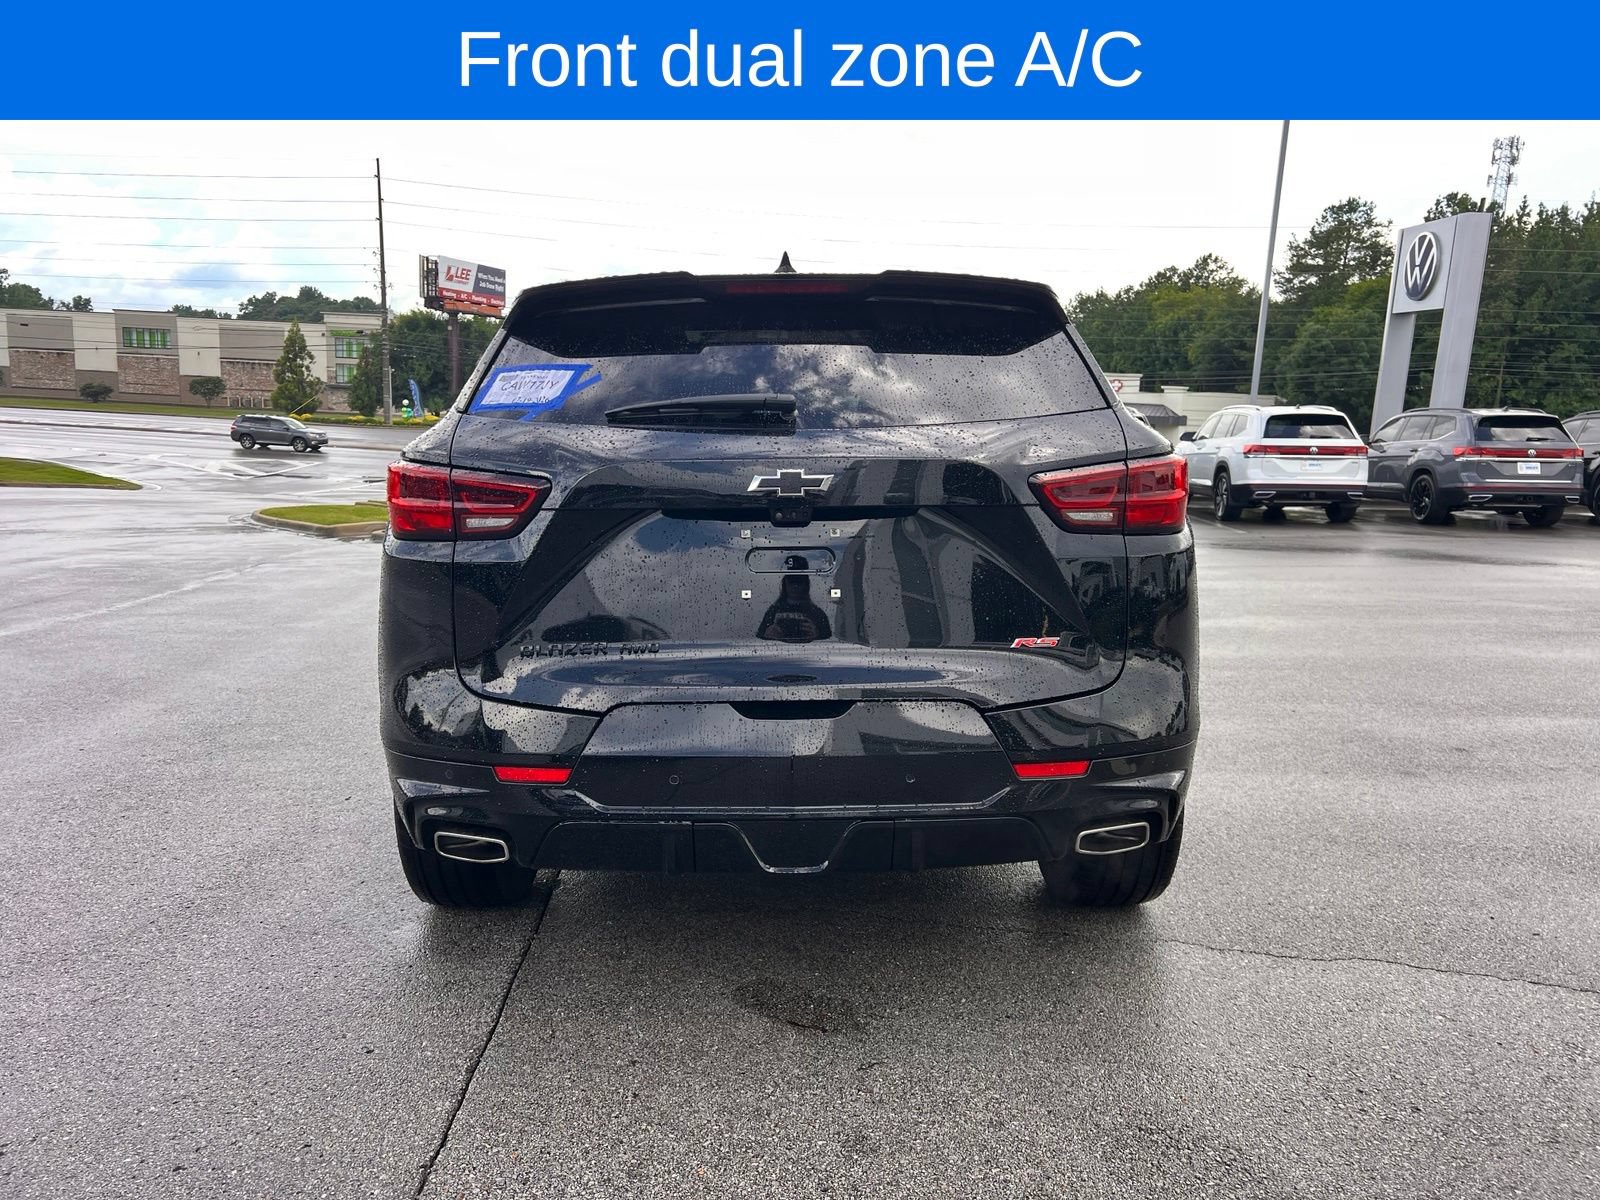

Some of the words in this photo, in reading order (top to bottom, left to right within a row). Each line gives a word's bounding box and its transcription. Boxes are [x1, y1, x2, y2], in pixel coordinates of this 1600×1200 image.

[455, 267, 472, 281] LEE
[520, 642, 608, 657] BLAZER
[619, 642, 660, 656] AWD
[1010, 637, 1060, 648] RS
